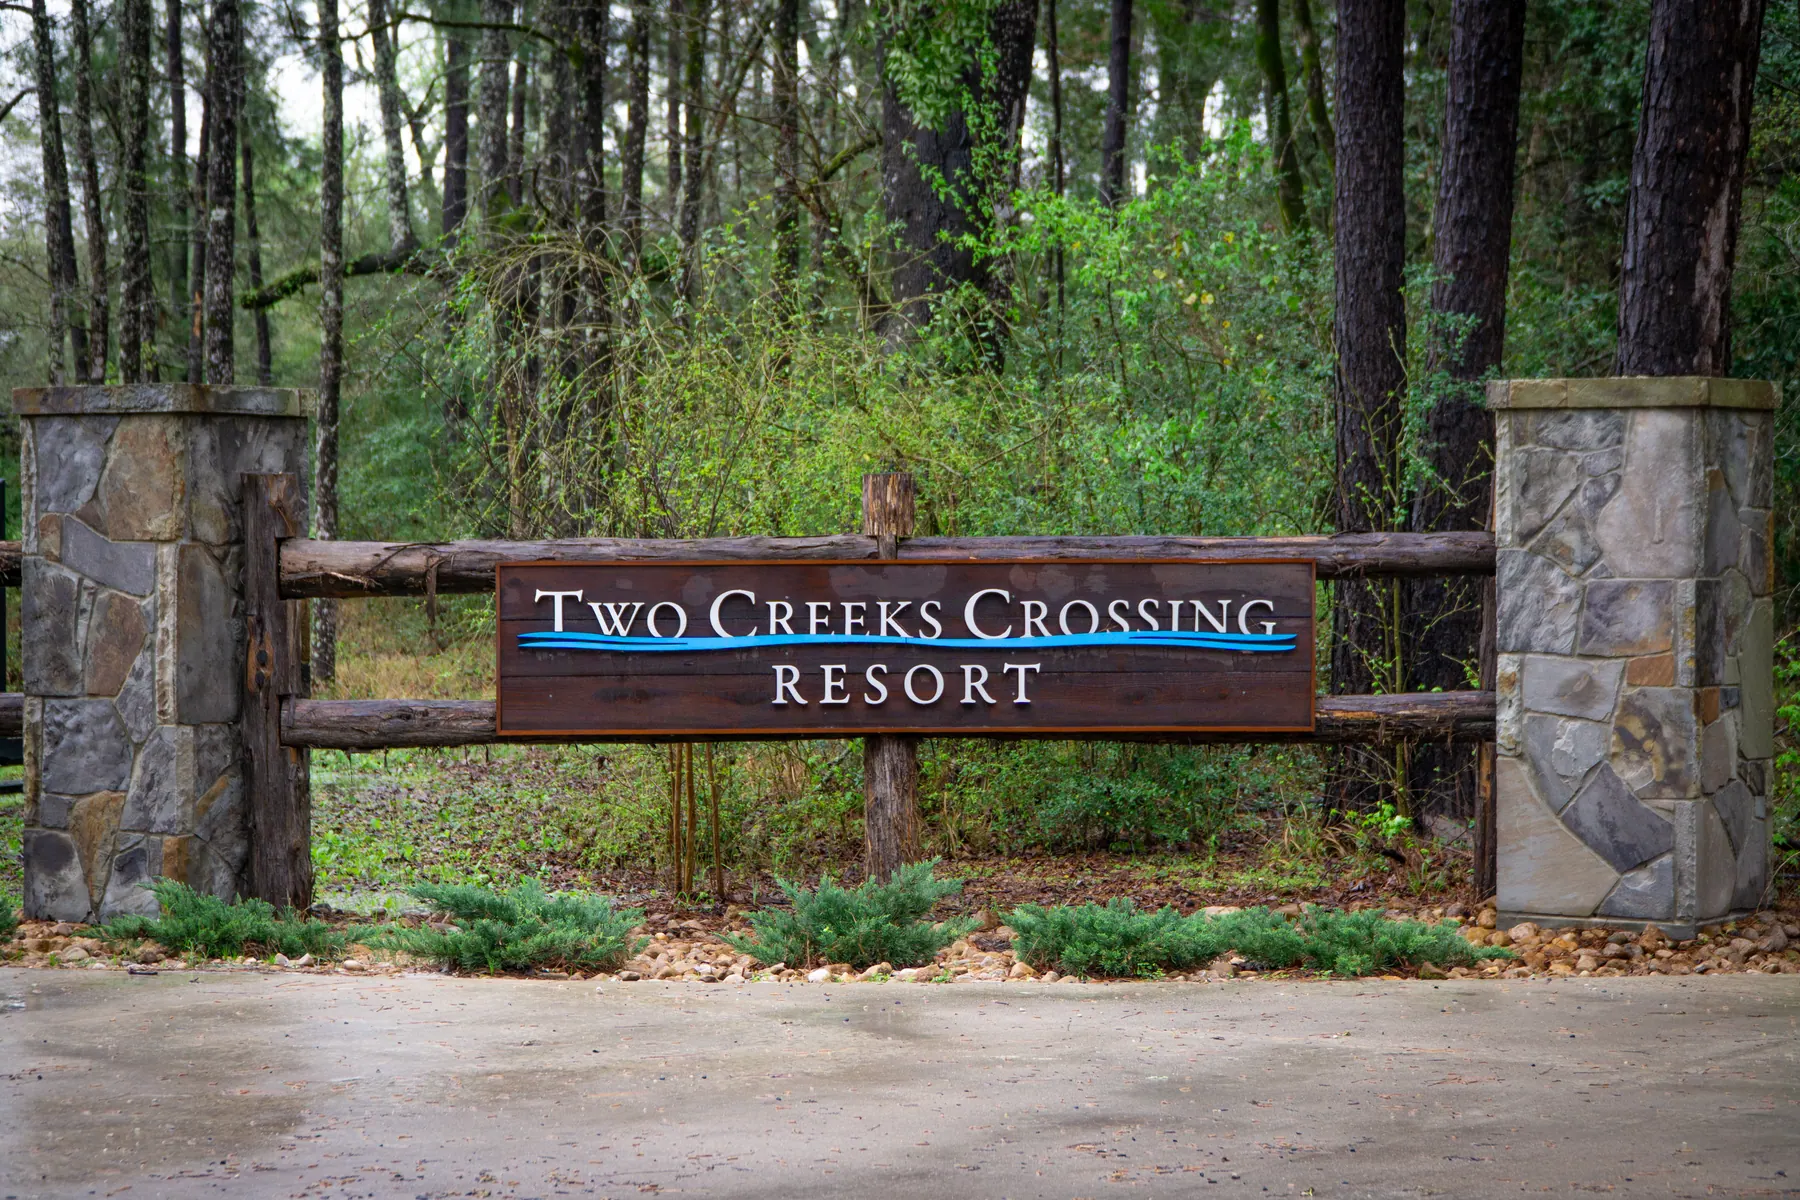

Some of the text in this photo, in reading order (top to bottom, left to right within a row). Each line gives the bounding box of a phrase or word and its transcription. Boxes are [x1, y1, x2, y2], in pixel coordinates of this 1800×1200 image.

[534, 588, 1277, 640] TWO CREEKS CROSSING
[771, 663, 1041, 705] RESORT
